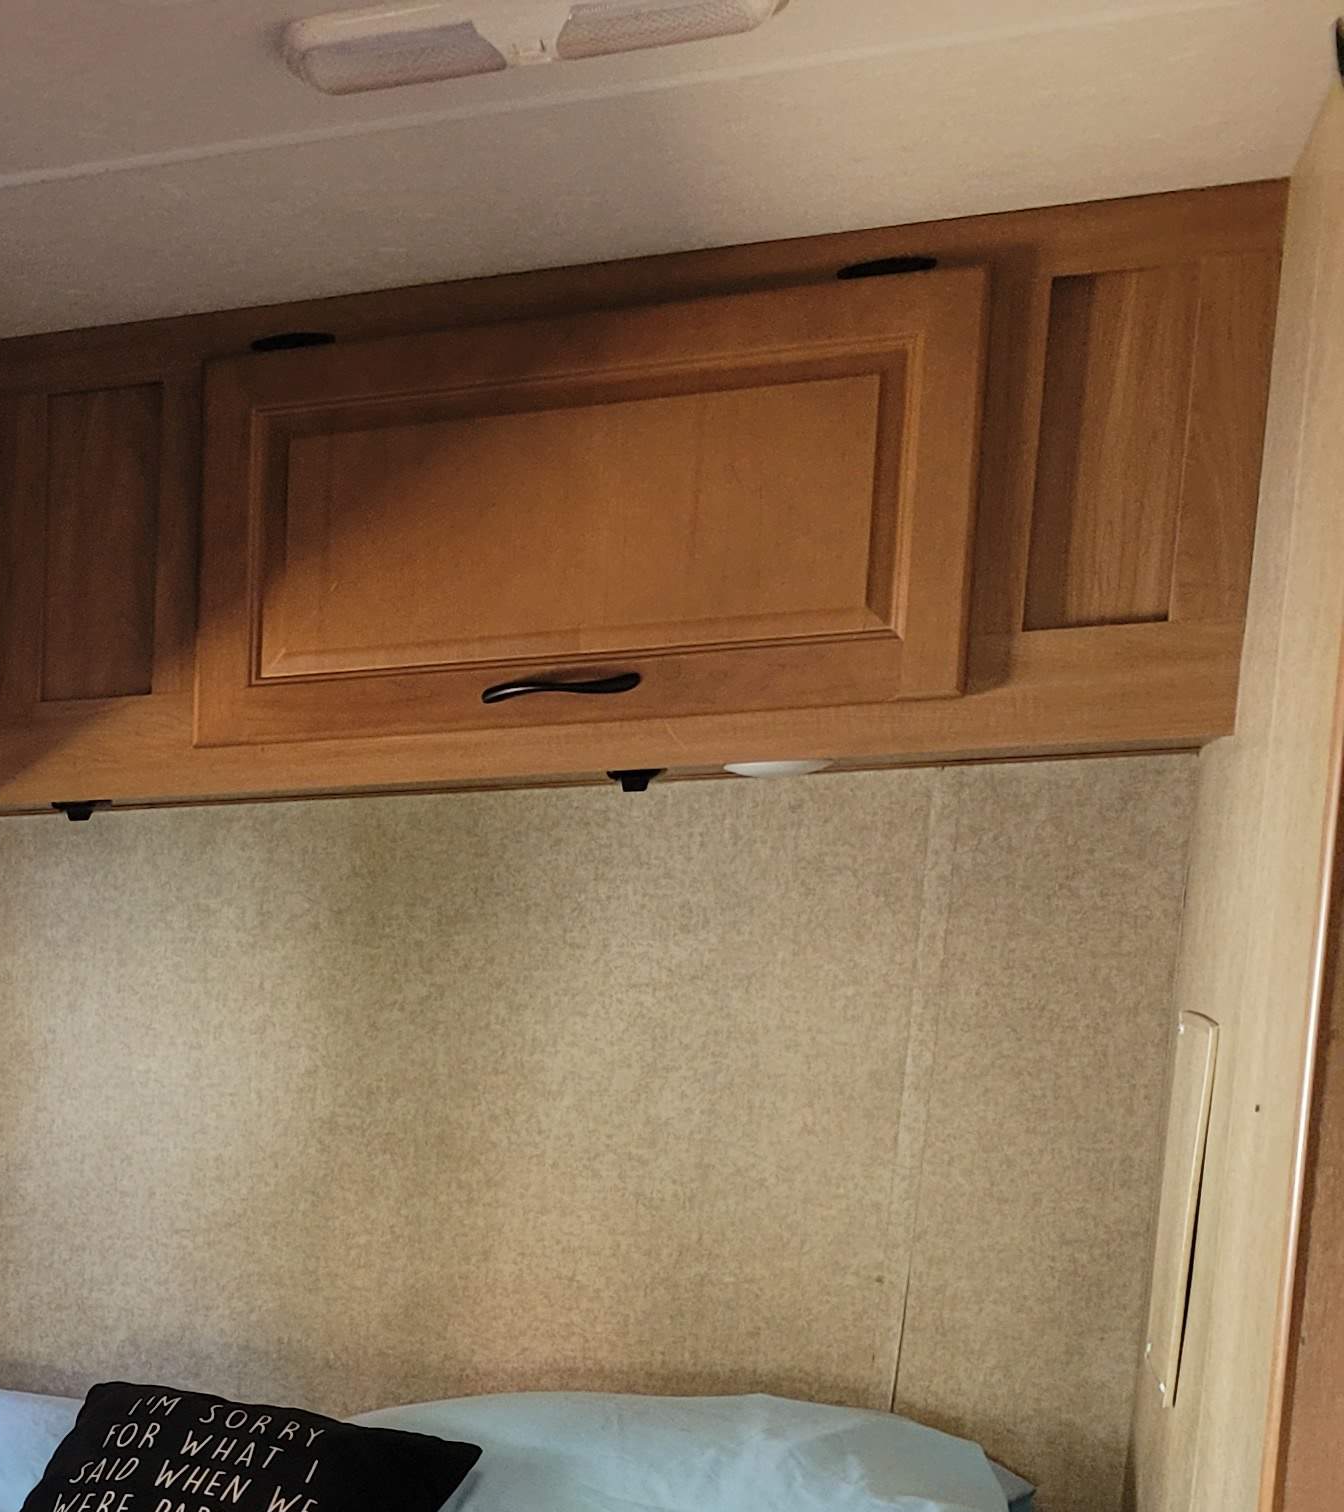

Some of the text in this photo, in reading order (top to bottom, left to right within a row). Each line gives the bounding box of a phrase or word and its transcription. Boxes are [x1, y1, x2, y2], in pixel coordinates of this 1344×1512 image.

[129, 1395, 325, 1447] I'M SORRY
[102, 1422, 319, 1484] FOR WHAT I
[68, 1457, 141, 1484] SAID
[154, 1459, 252, 1504] WHEN
